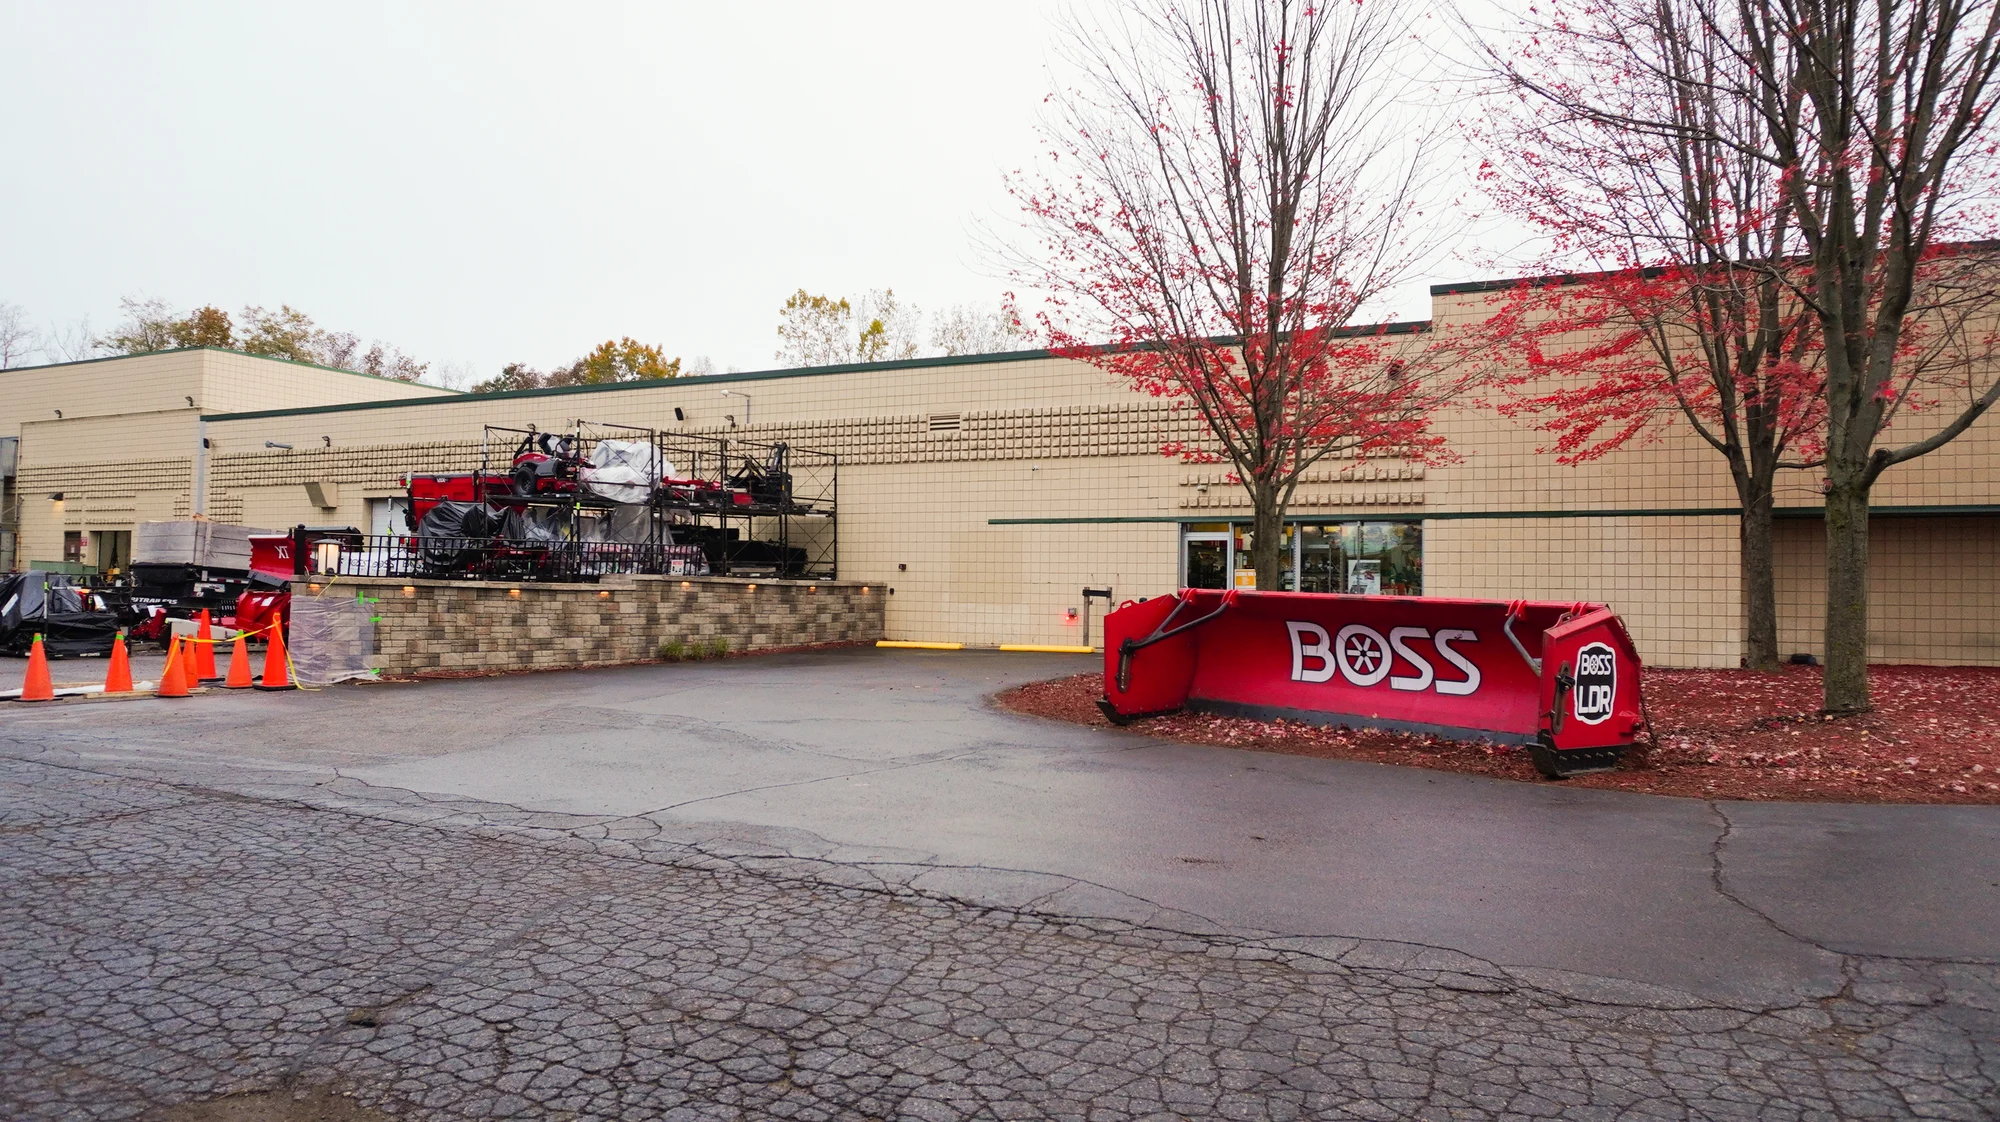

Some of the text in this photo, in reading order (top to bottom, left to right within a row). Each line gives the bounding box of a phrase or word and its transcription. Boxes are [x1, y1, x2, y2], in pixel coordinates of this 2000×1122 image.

[1286, 621, 1480, 695] BOSS
[1581, 654, 1612, 676] BOSS
[1578, 685, 1611, 714] LDR
